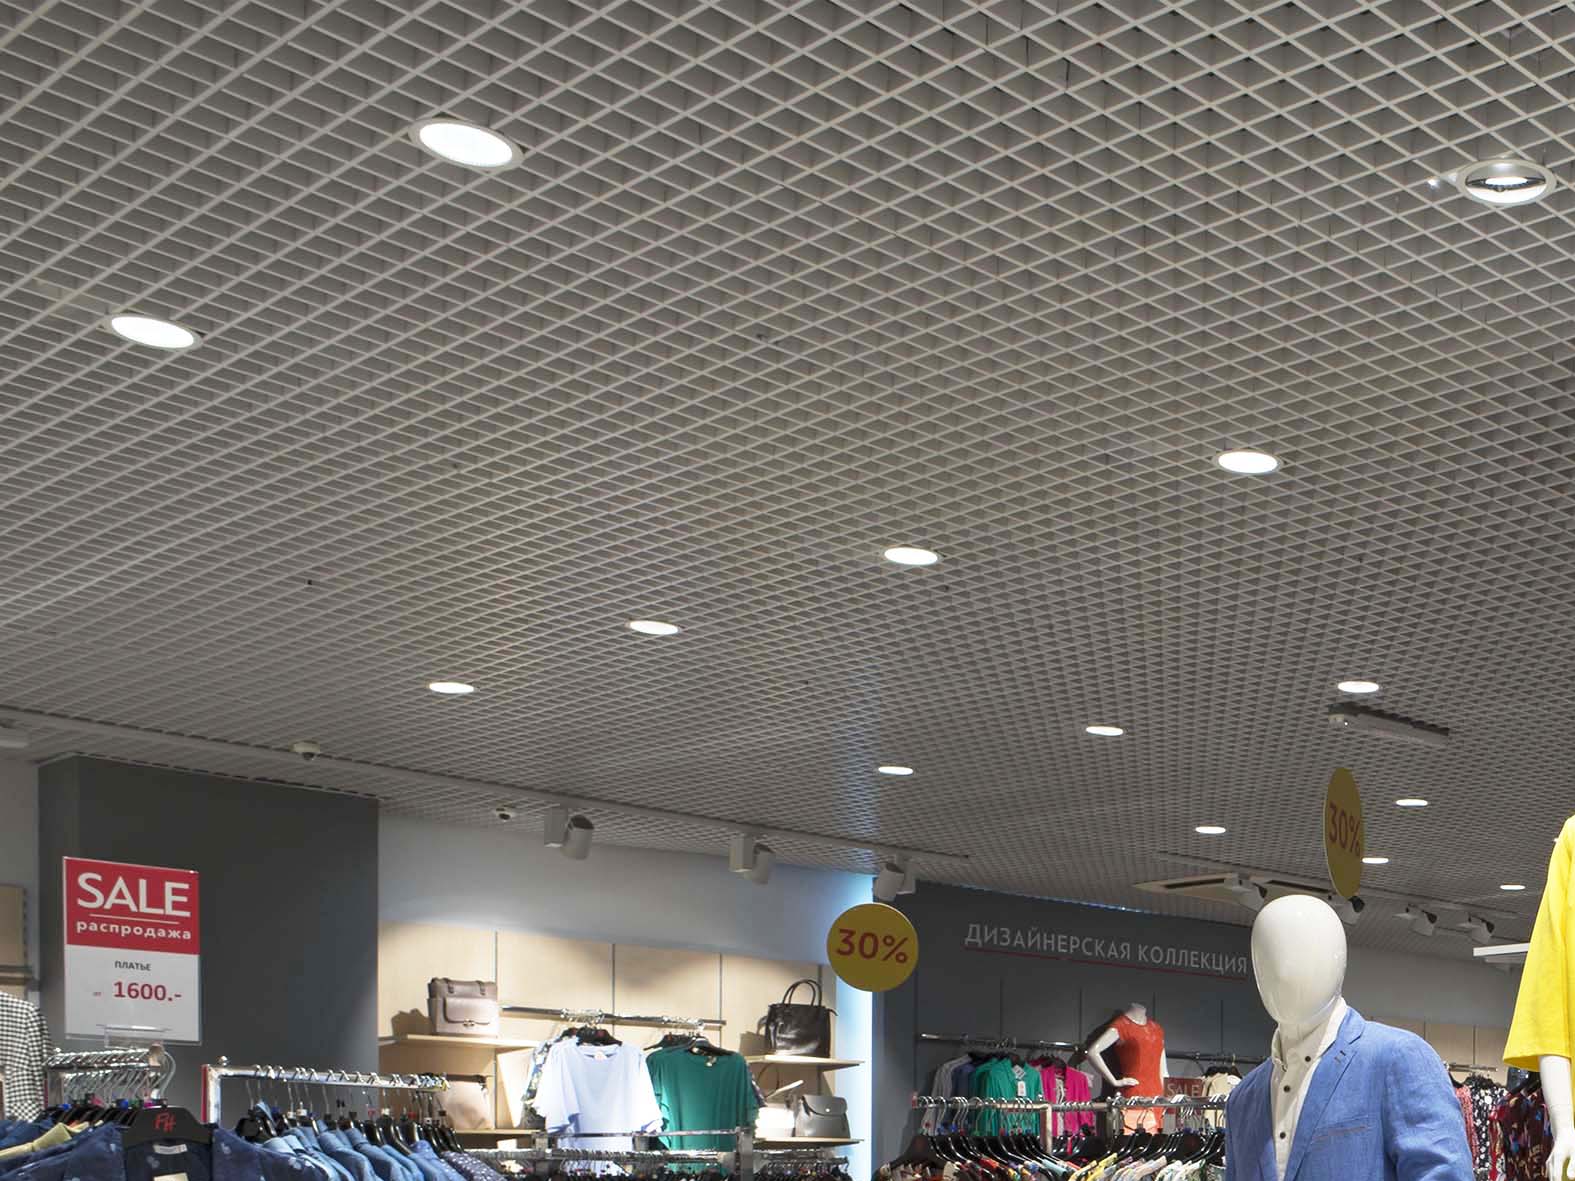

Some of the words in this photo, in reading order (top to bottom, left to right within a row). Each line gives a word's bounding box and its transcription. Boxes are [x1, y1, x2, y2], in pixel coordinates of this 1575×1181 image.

[1328, 801, 1361, 857] 30%
[76, 872, 191, 918] SALE
[76, 920, 192, 940] распродажа
[835, 928, 909, 964] 30%
[114, 960, 151, 971] ПЛАТЬЕ
[964, 923, 1131, 961] ДИЗАЙНЕРСКАЯ
[1137, 944, 1247, 974] КОЛЛЕКЦИЯ
[1167, 1083, 1201, 1097] SALE
